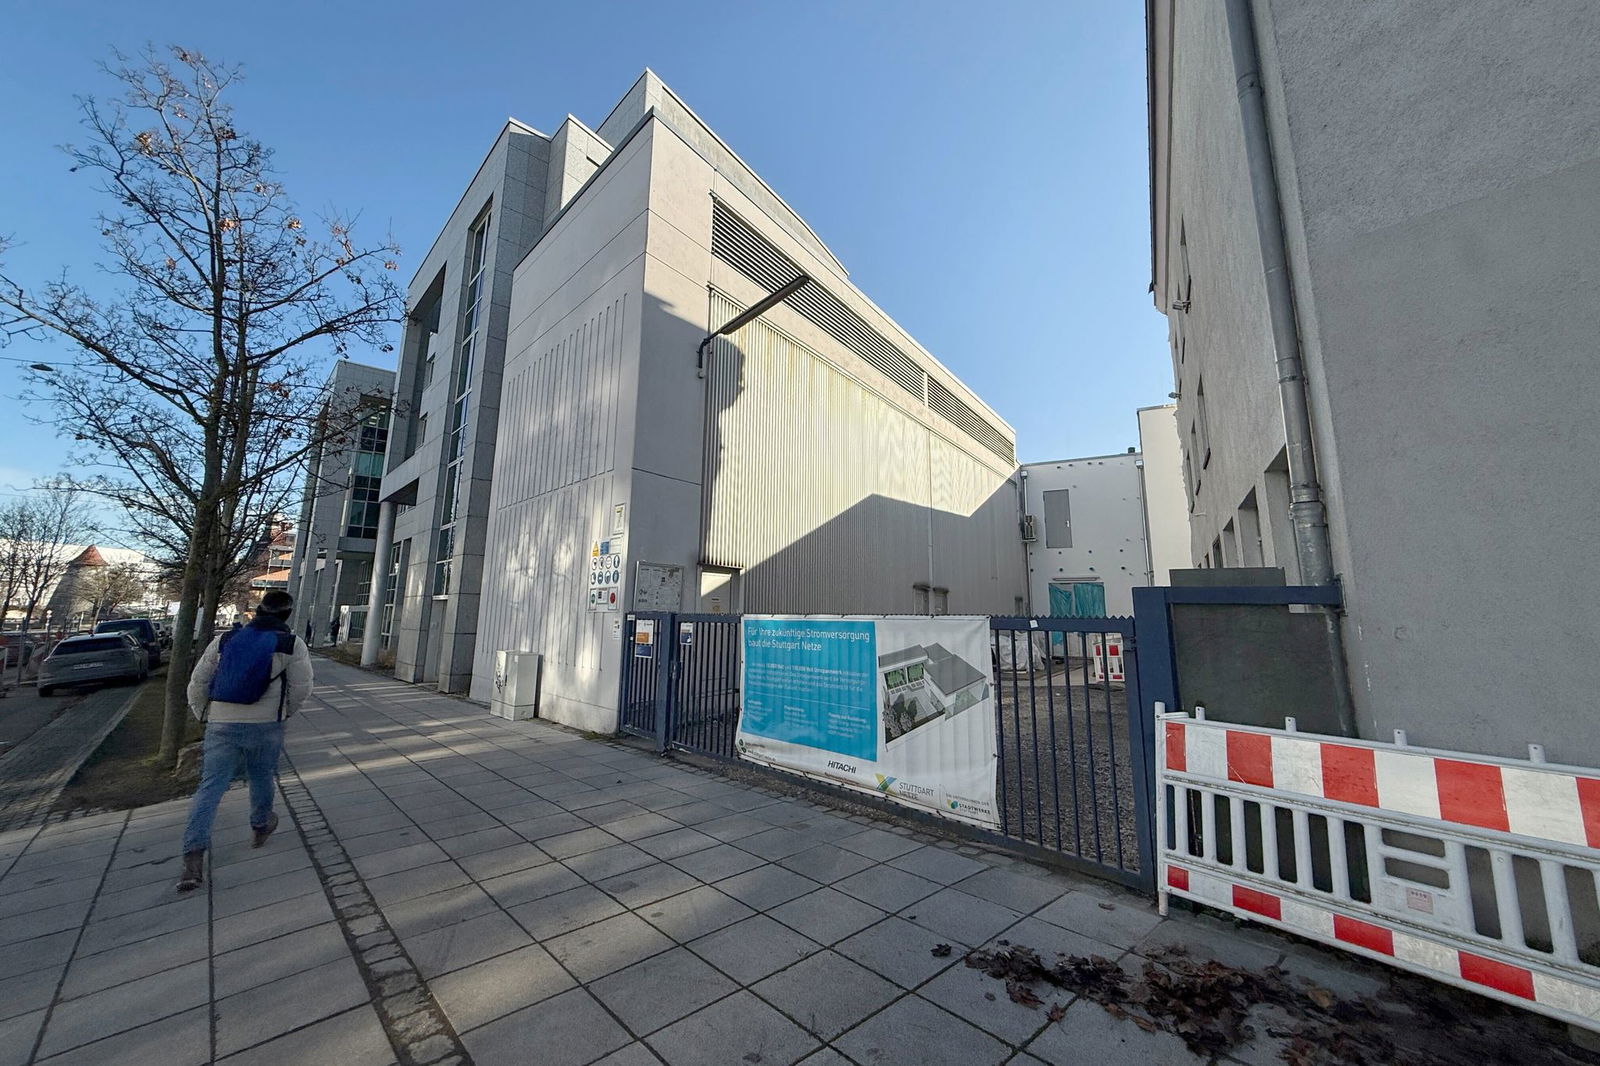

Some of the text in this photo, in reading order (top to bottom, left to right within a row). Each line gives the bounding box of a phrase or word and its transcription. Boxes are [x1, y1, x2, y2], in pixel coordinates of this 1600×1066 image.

[747, 626, 870, 643] Für Ihre zukünftige Stromversorgung
[748, 639, 822, 652] baut die Stuttgart Netze
[827, 760, 857, 774] HITACHI
[899, 782, 934, 797] STUTTGART
[958, 802, 991, 815] STADTWERKE
